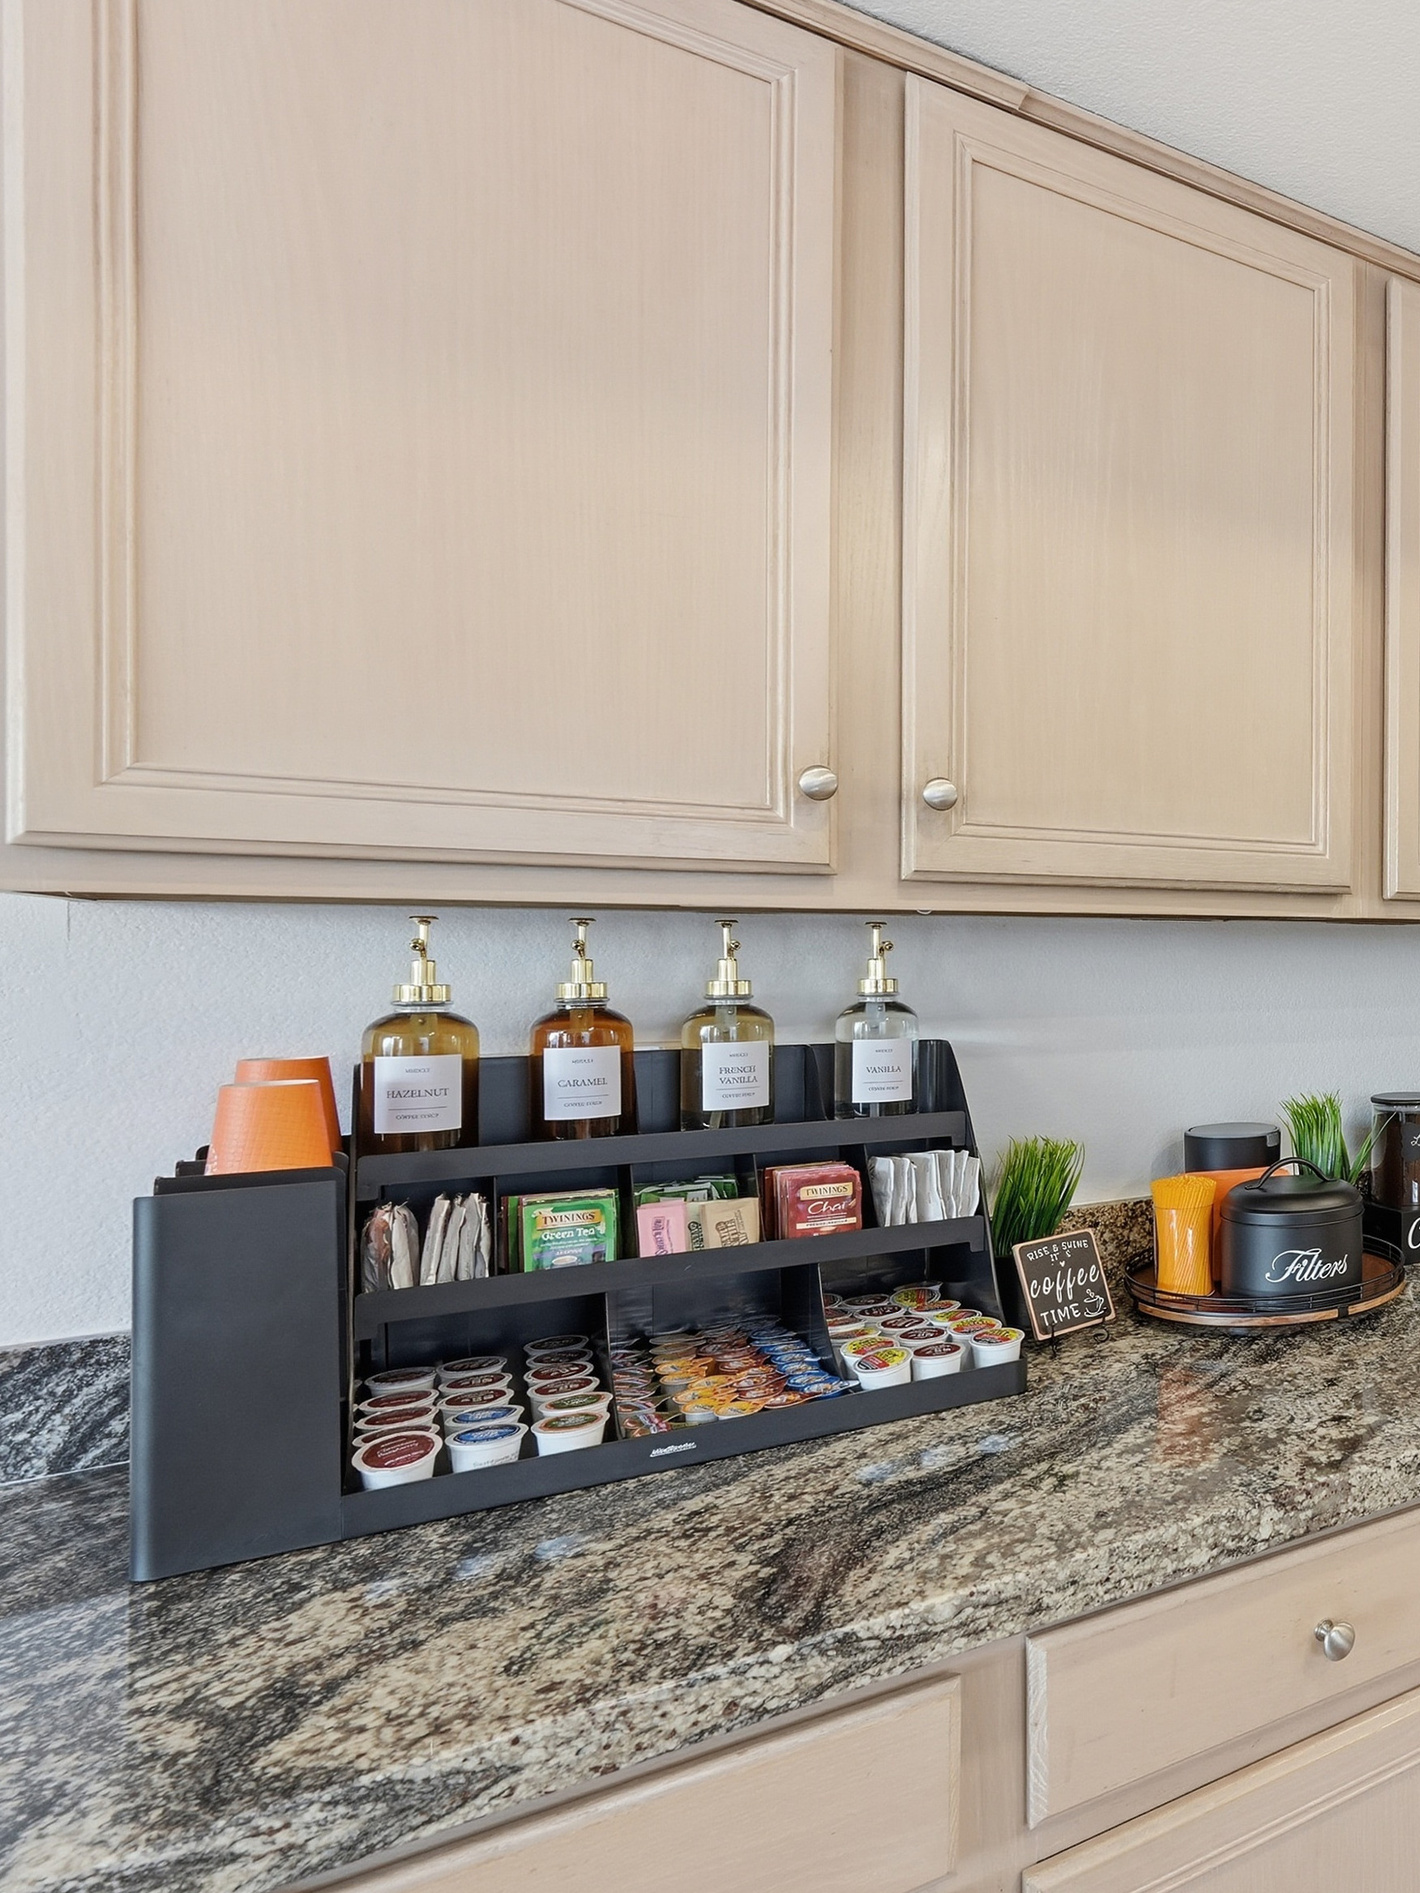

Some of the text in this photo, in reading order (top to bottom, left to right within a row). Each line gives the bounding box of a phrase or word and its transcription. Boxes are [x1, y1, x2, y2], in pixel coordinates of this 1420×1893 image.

[719, 1065, 756, 1074] FRENCH
[866, 1065, 902, 1074] VANILLA
[557, 1077, 608, 1088] CARAMEL
[719, 1075, 758, 1085] VANILLA
[386, 1087, 449, 1099] HAZELNUT
[806, 1185, 848, 1196] TWININGS
[808, 1201, 846, 1215] Chai
[542, 1211, 596, 1225] TWININGS
[542, 1227, 596, 1241] Green Tea
[1026, 1246, 1050, 1261] RISE
[1061, 1239, 1089, 1251] SHINE
[1265, 1248, 1348, 1283] Filters
[1030, 1264, 1100, 1303] coffee
[1040, 1303, 1081, 1326] TIME
